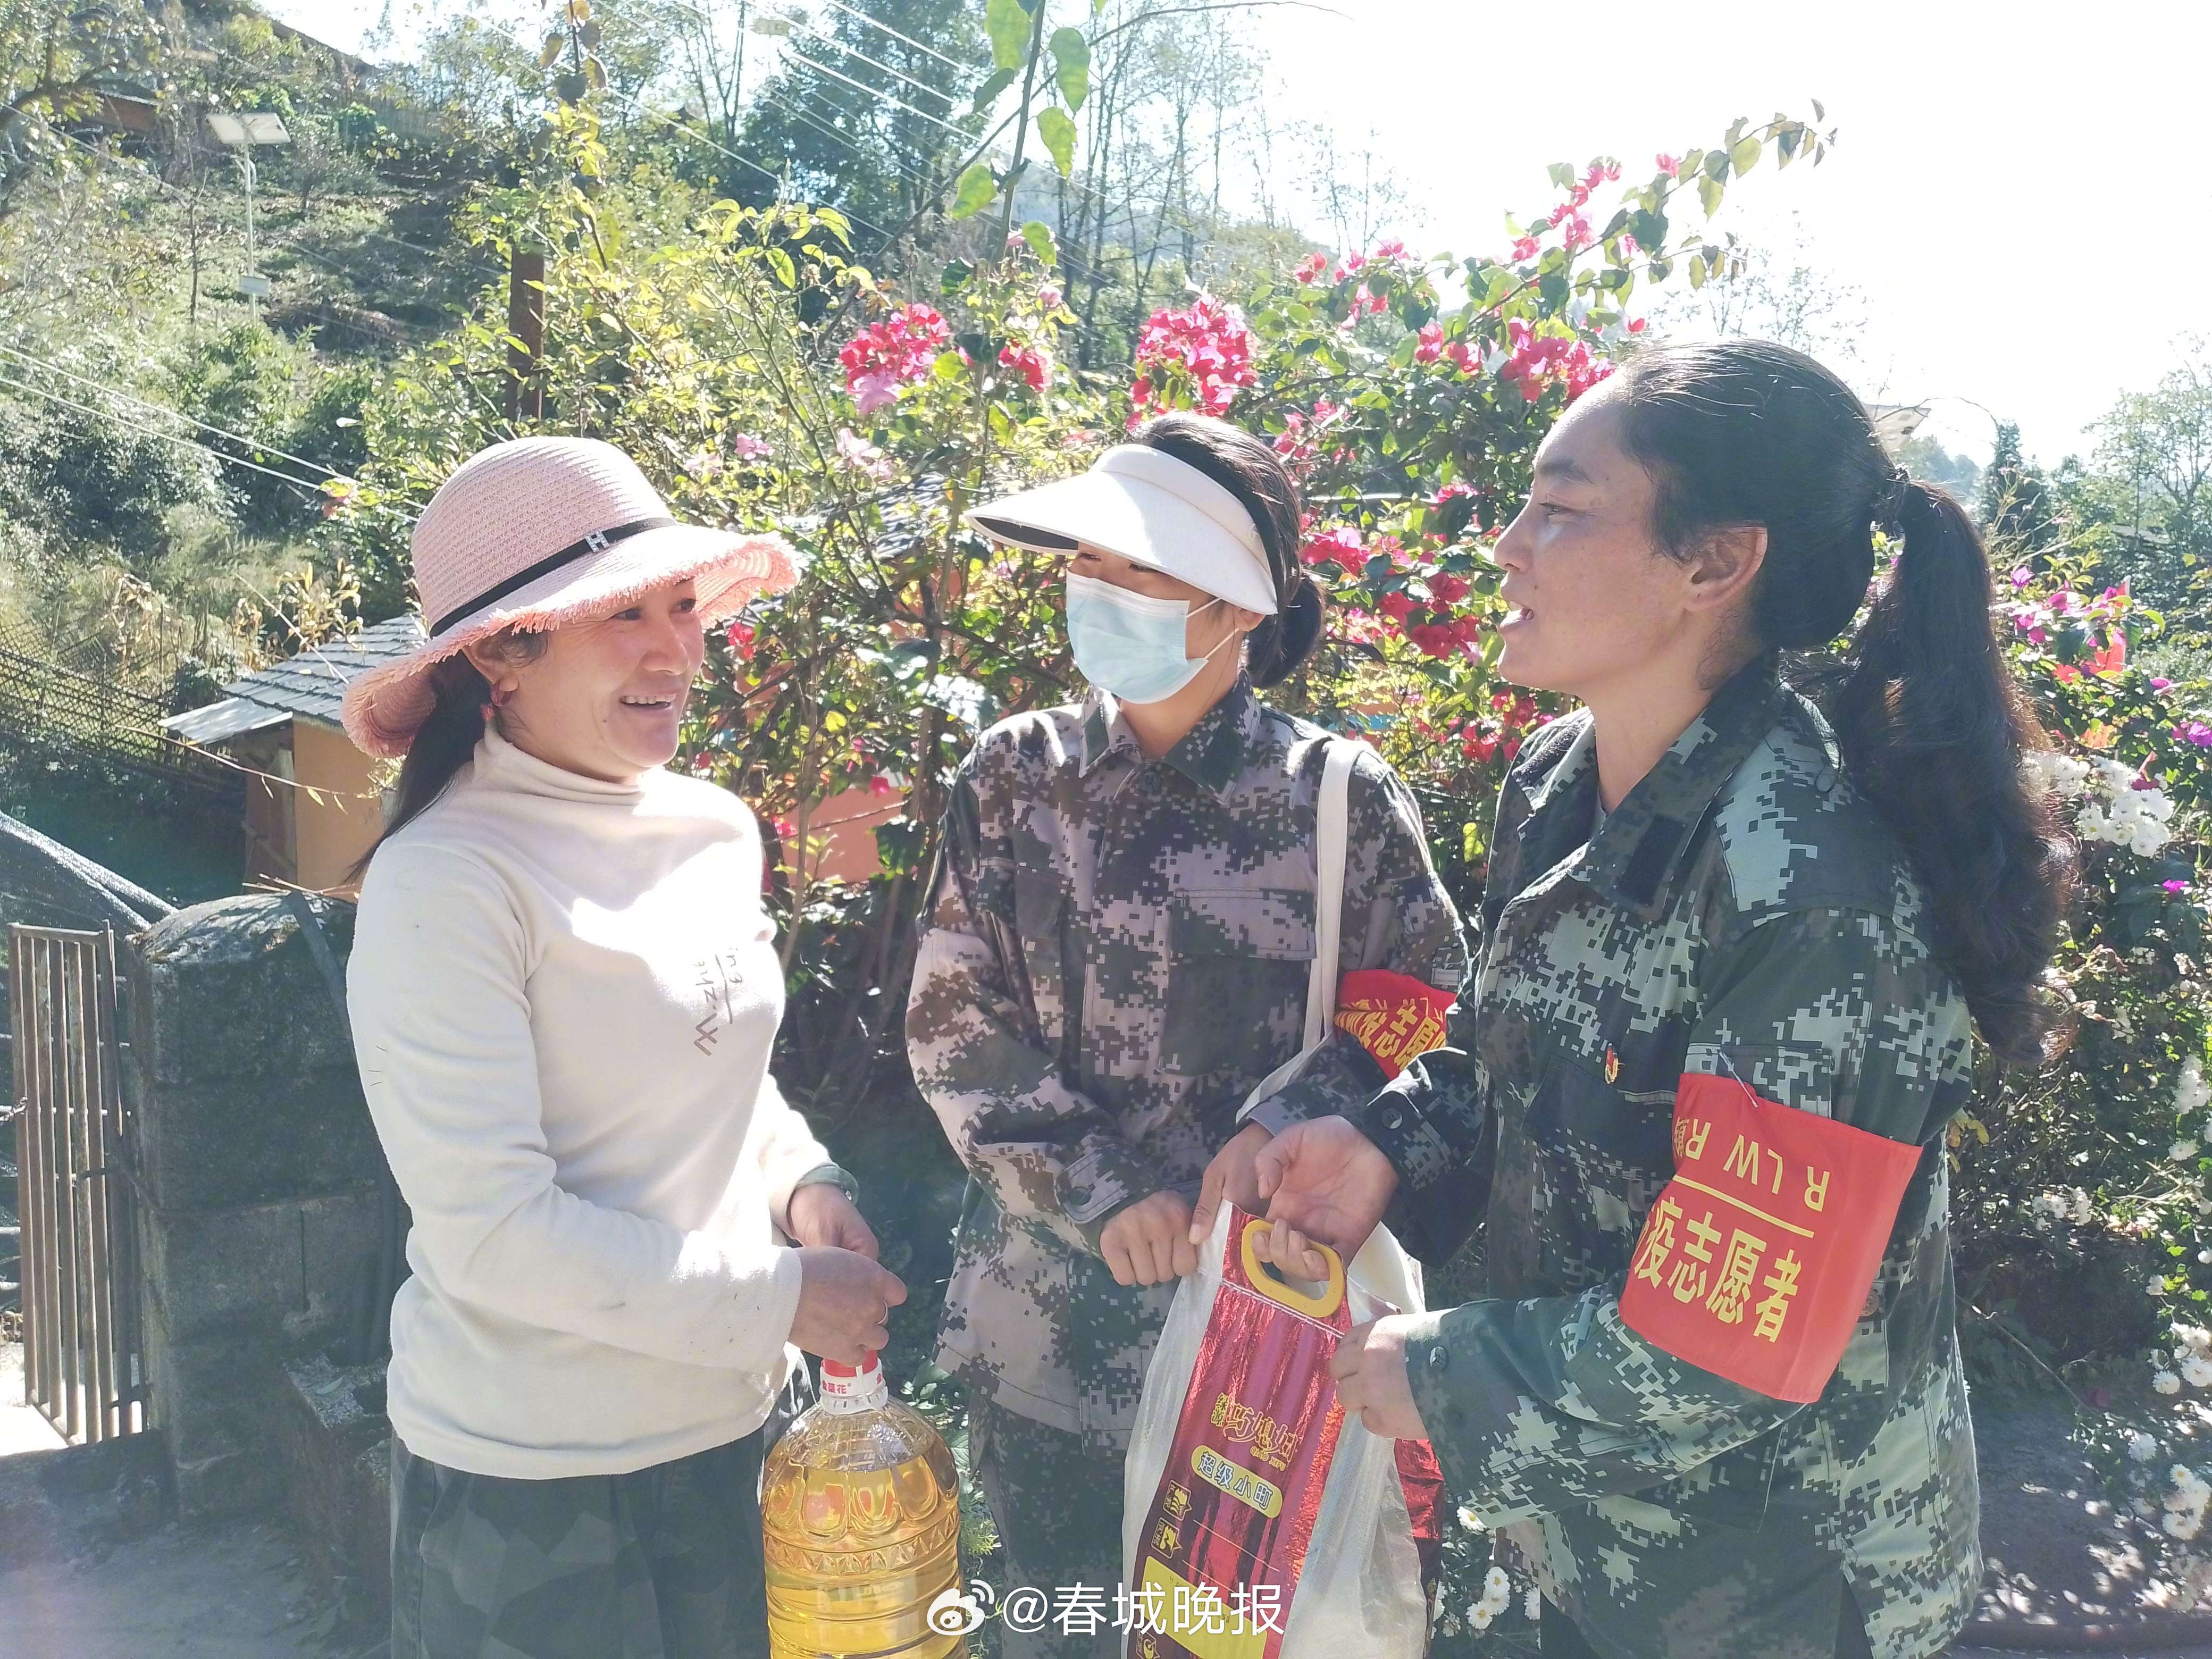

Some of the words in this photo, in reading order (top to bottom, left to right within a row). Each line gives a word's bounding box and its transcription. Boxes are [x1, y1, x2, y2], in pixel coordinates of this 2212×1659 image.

[584, 530, 609, 552] H
[1631, 1196, 1802, 1343] 疫志愿者
[1198, 1451, 1273, 1510] 超级小町
